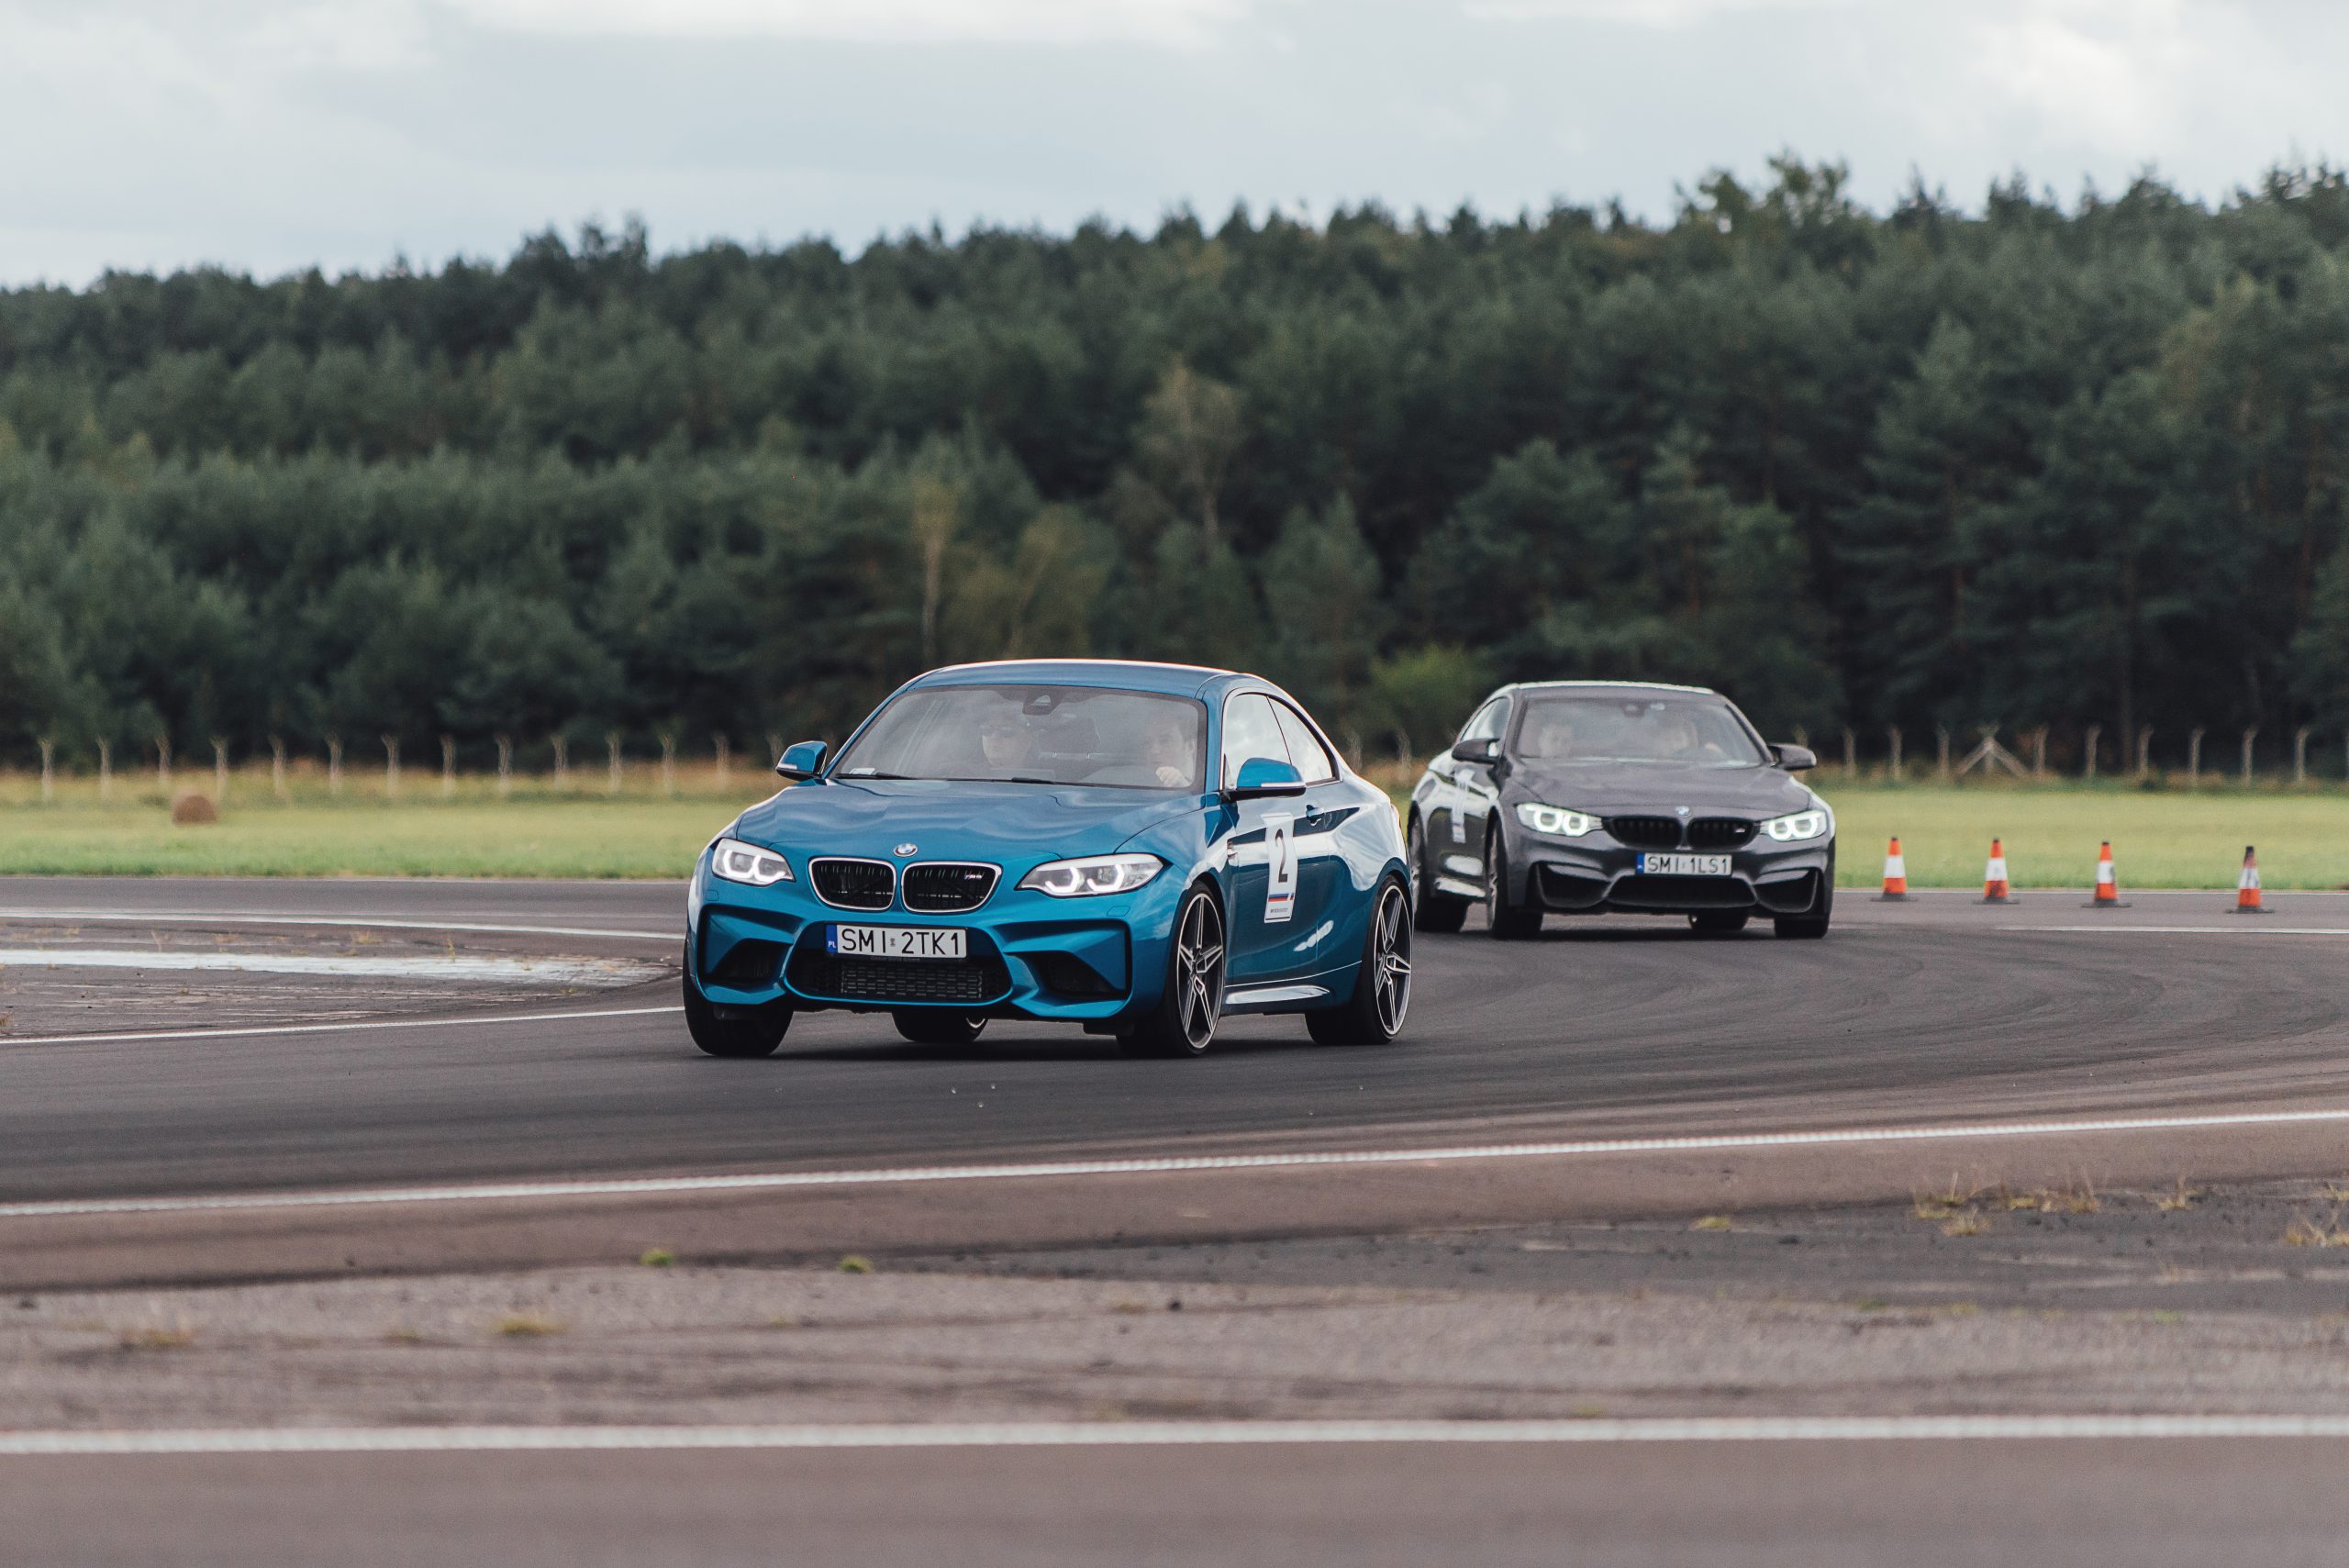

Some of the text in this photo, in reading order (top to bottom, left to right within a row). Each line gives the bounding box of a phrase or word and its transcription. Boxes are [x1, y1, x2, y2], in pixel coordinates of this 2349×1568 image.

[1275, 828, 1288, 883] 2
[1648, 856, 1727, 873] SMI 1LS1
[841, 928, 959, 956] SMI 2TK1
